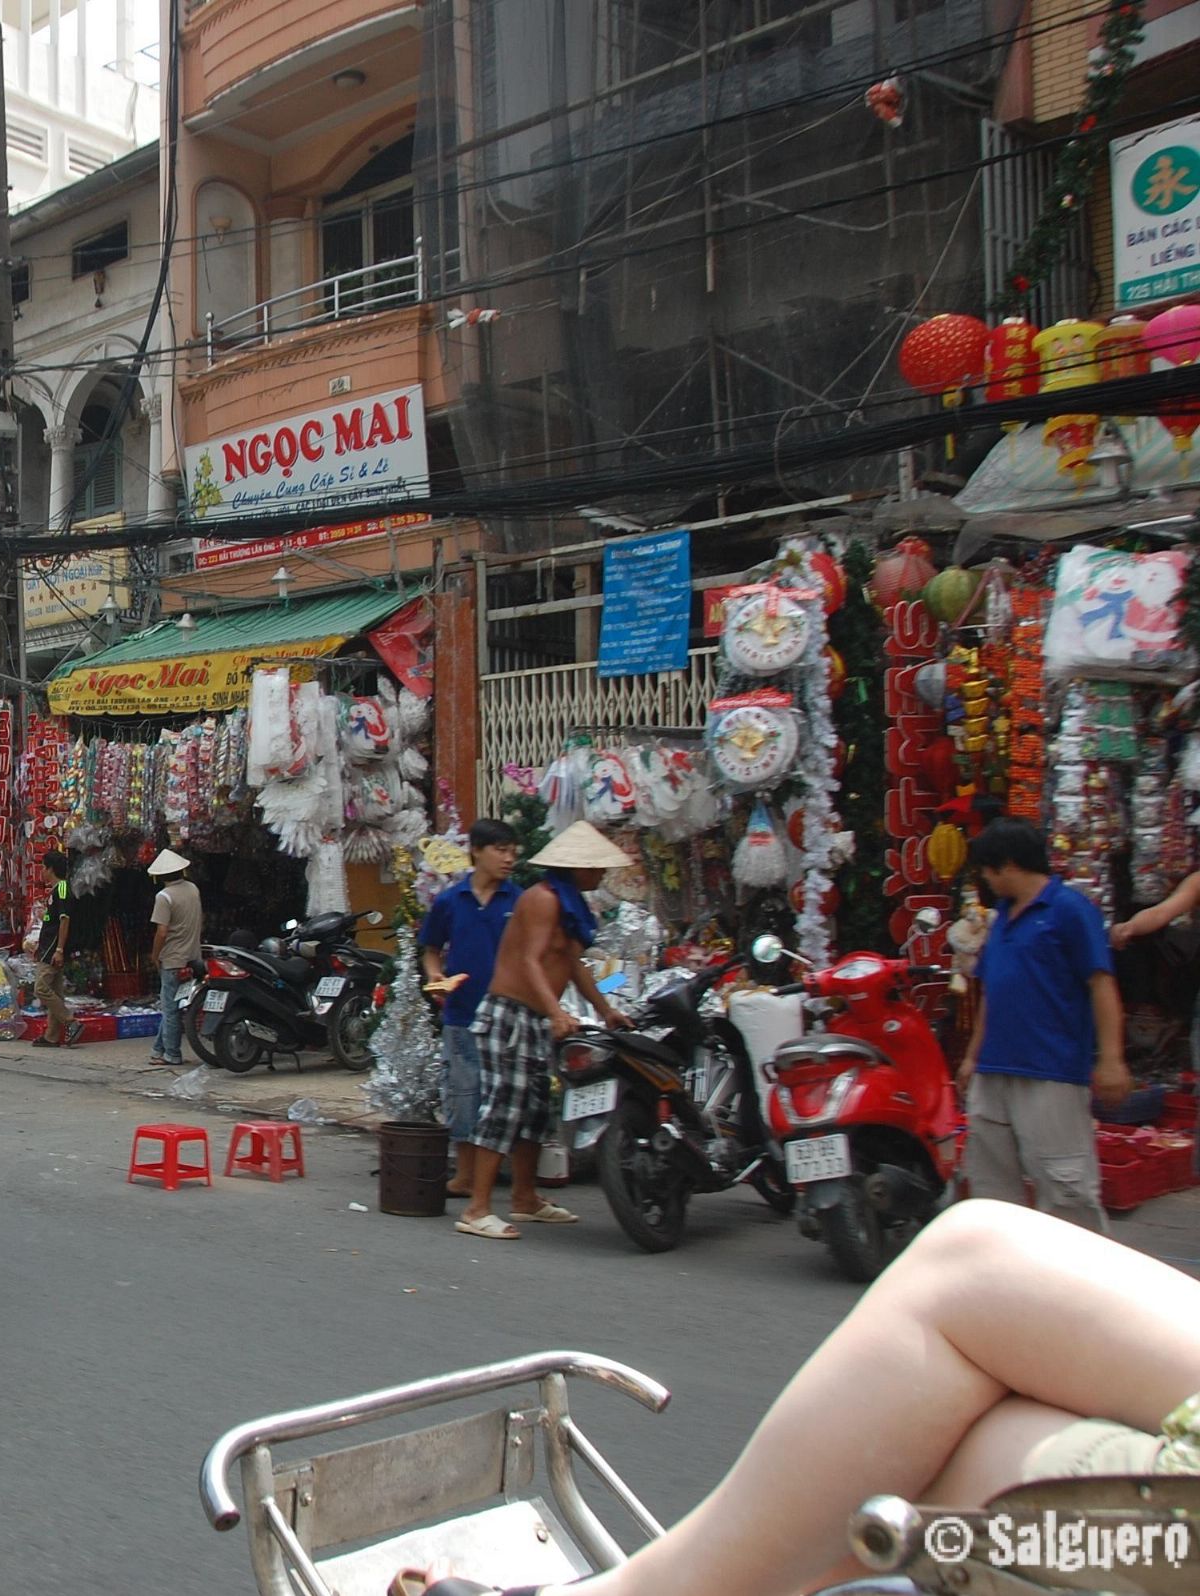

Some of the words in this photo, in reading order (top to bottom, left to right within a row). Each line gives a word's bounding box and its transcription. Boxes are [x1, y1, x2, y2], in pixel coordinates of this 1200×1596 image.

[1126, 227, 1158, 247] BÁN
[1160, 217, 1194, 239] CÁC
[1126, 281, 1151, 300] 225
[221, 419, 325, 482] NGỌC
[332, 395, 414, 456] MAI
[232, 490, 272, 510] Chuyên
[275, 480, 306, 499] Cung
[309, 473, 335, 490] Cấp
[358, 461, 368, 478] &
[74, 669, 147, 697] Ngọc
[147, 659, 211, 690] Mai
[211, 690, 230, 706] SINH
[716, 744, 778, 777] CHRISTMAS
